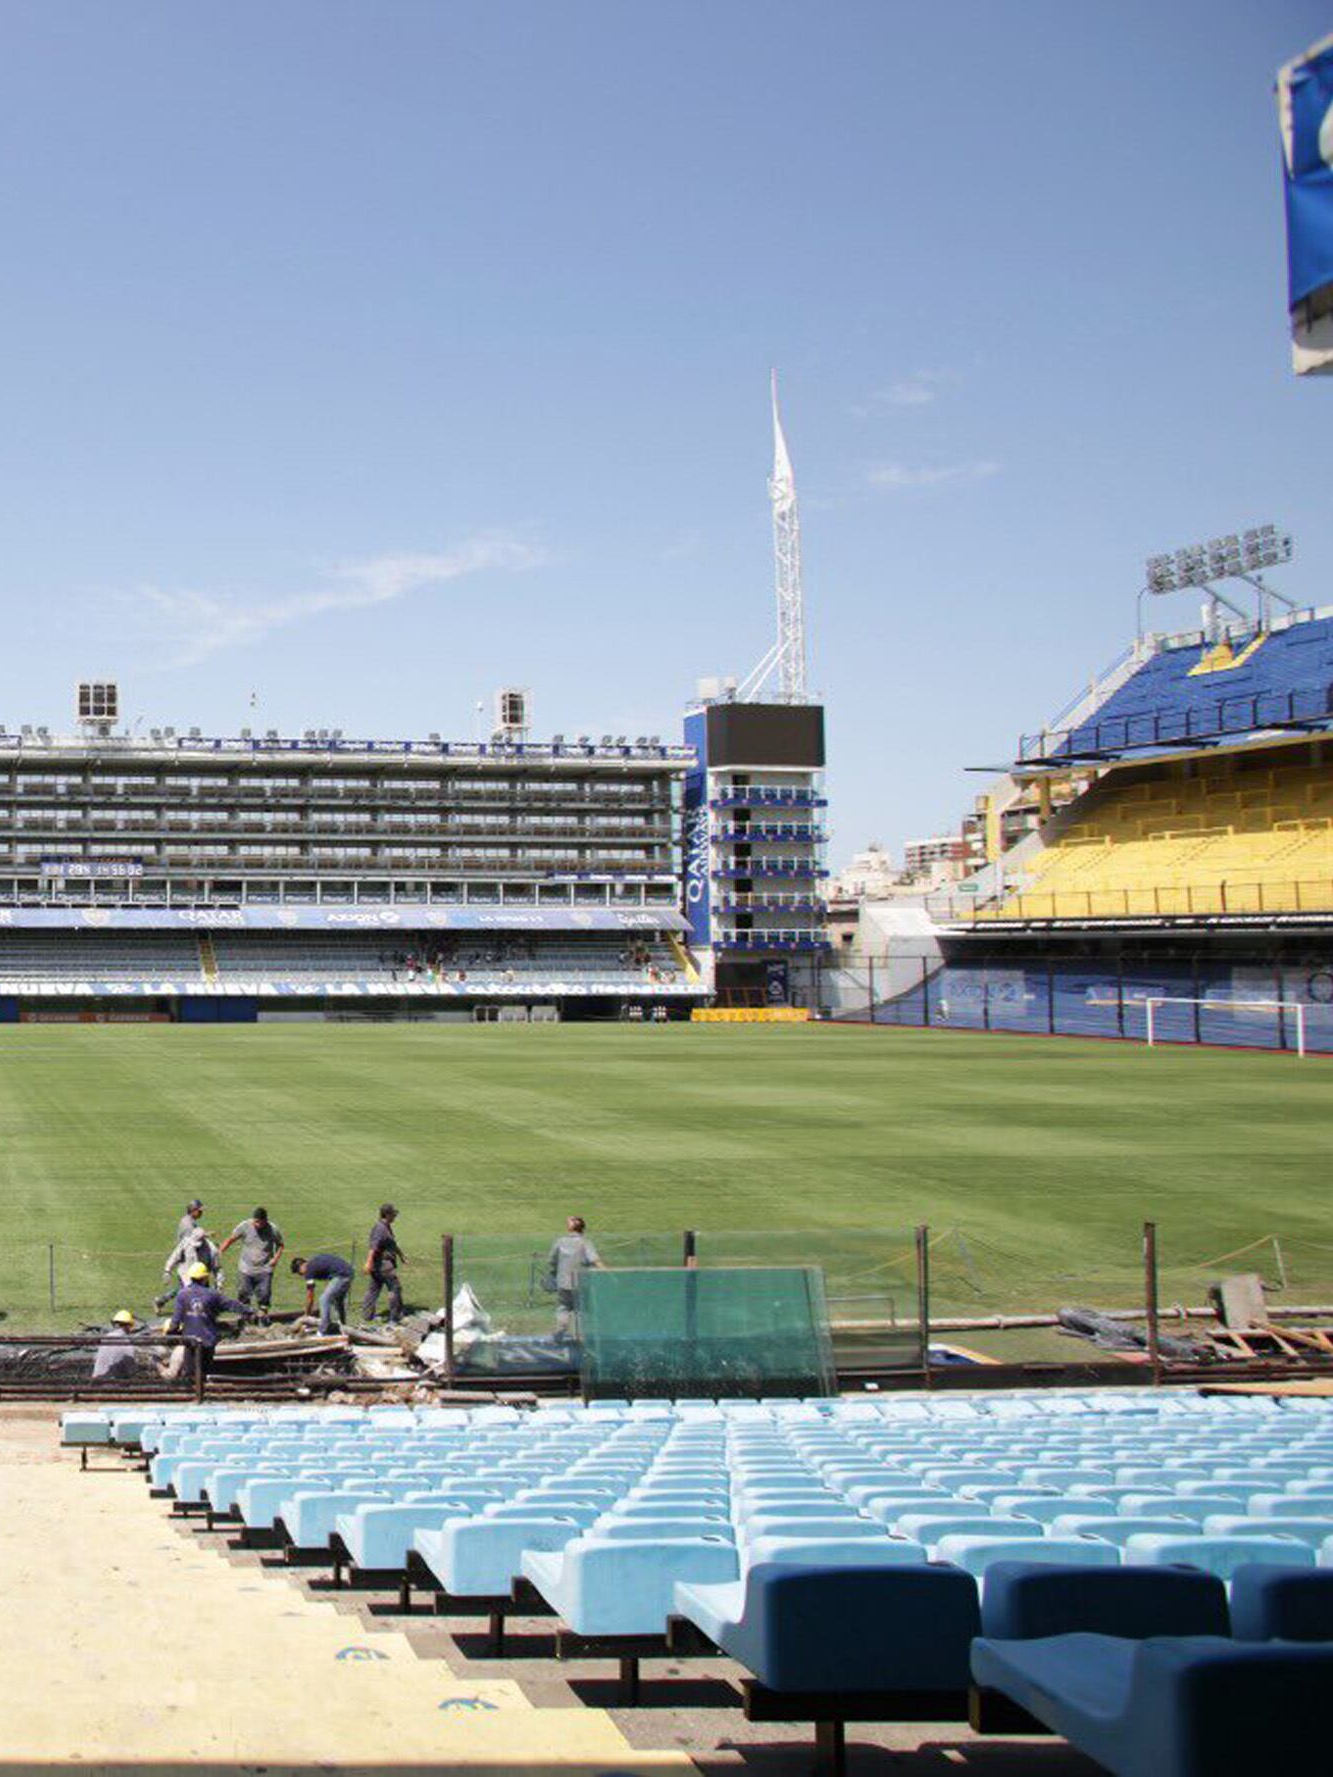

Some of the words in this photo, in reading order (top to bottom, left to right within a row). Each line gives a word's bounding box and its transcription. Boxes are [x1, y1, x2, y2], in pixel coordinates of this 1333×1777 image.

[0, 983, 95, 995] NUEVA
[142, 983, 179, 995] LA
[185, 983, 277, 995] NUEVA
[323, 983, 361, 995] LA
[365, 983, 460, 995] NUEVA
